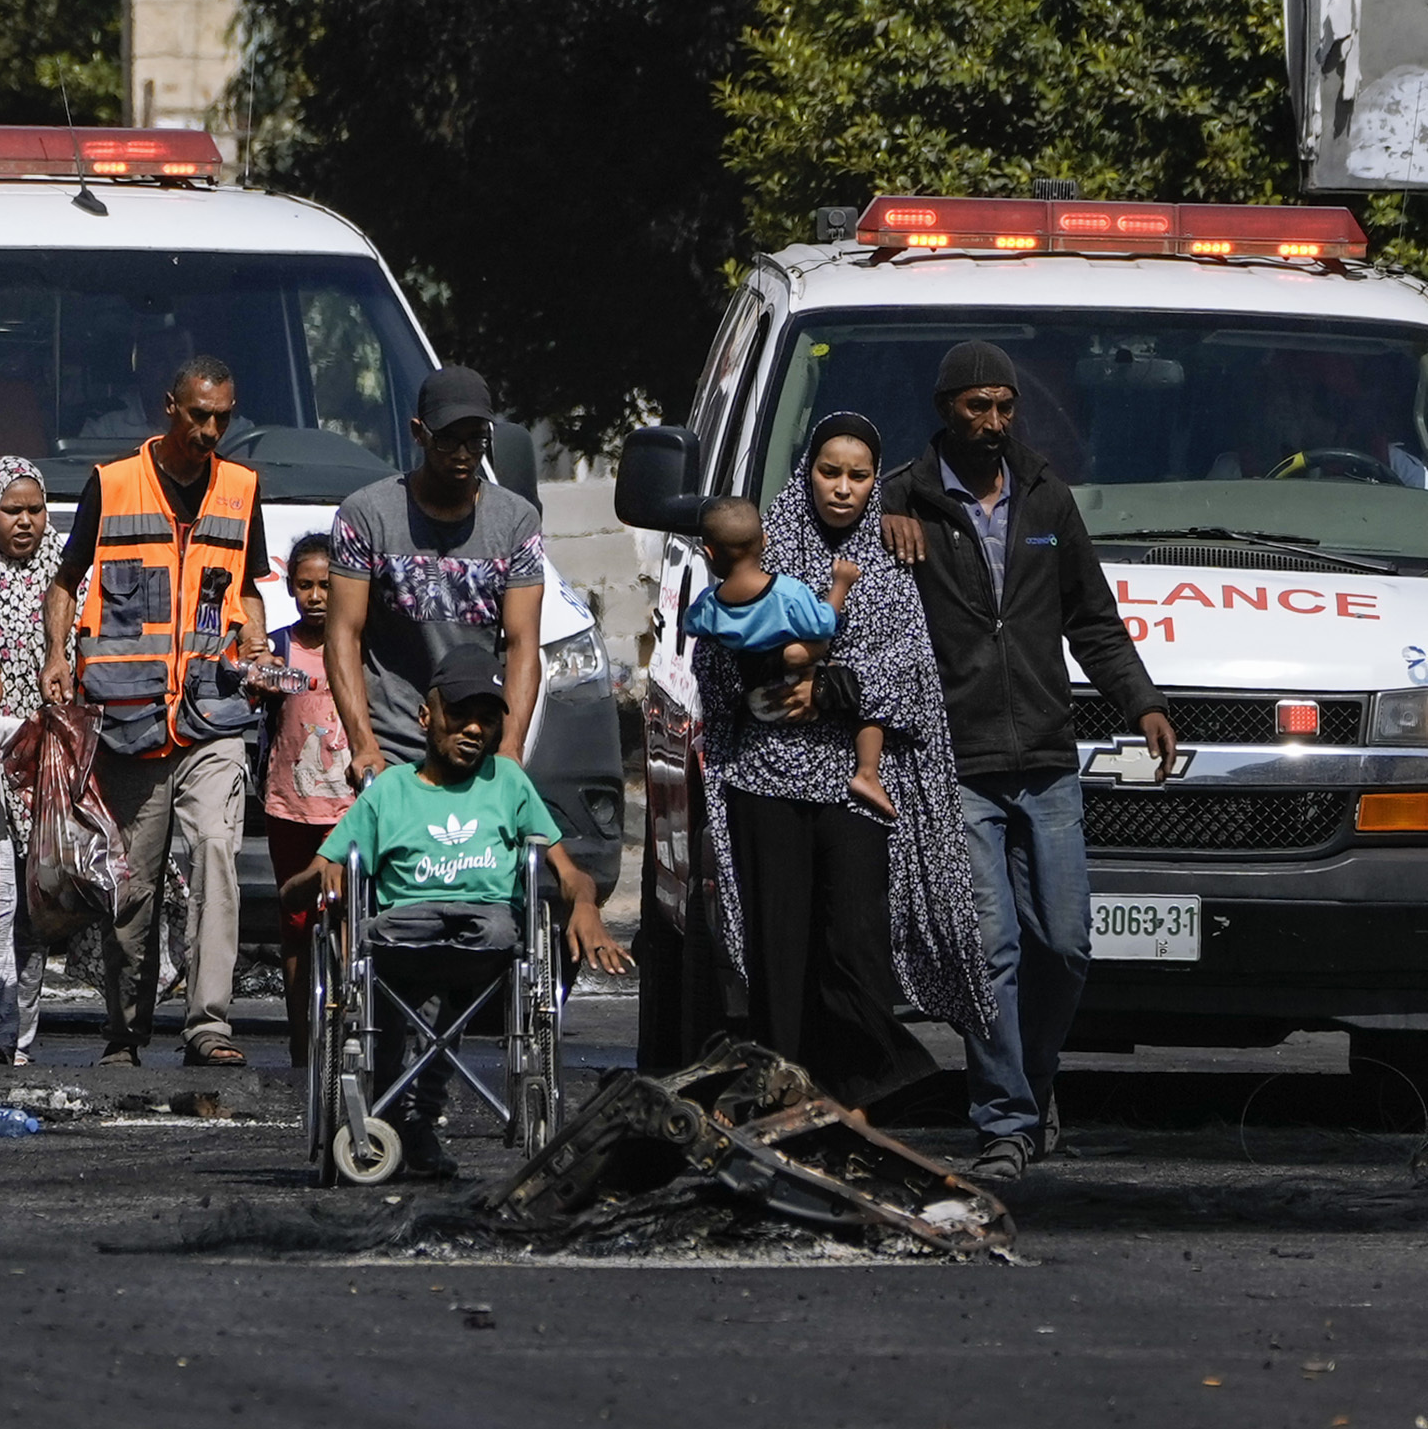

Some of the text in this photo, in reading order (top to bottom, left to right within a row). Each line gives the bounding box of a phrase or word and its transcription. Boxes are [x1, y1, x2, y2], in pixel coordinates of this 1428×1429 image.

[1116, 579, 1382, 621] LANCE
[197, 604, 219, 630] UN
[1122, 615, 1176, 643] 01
[414, 845, 497, 884] Originals
